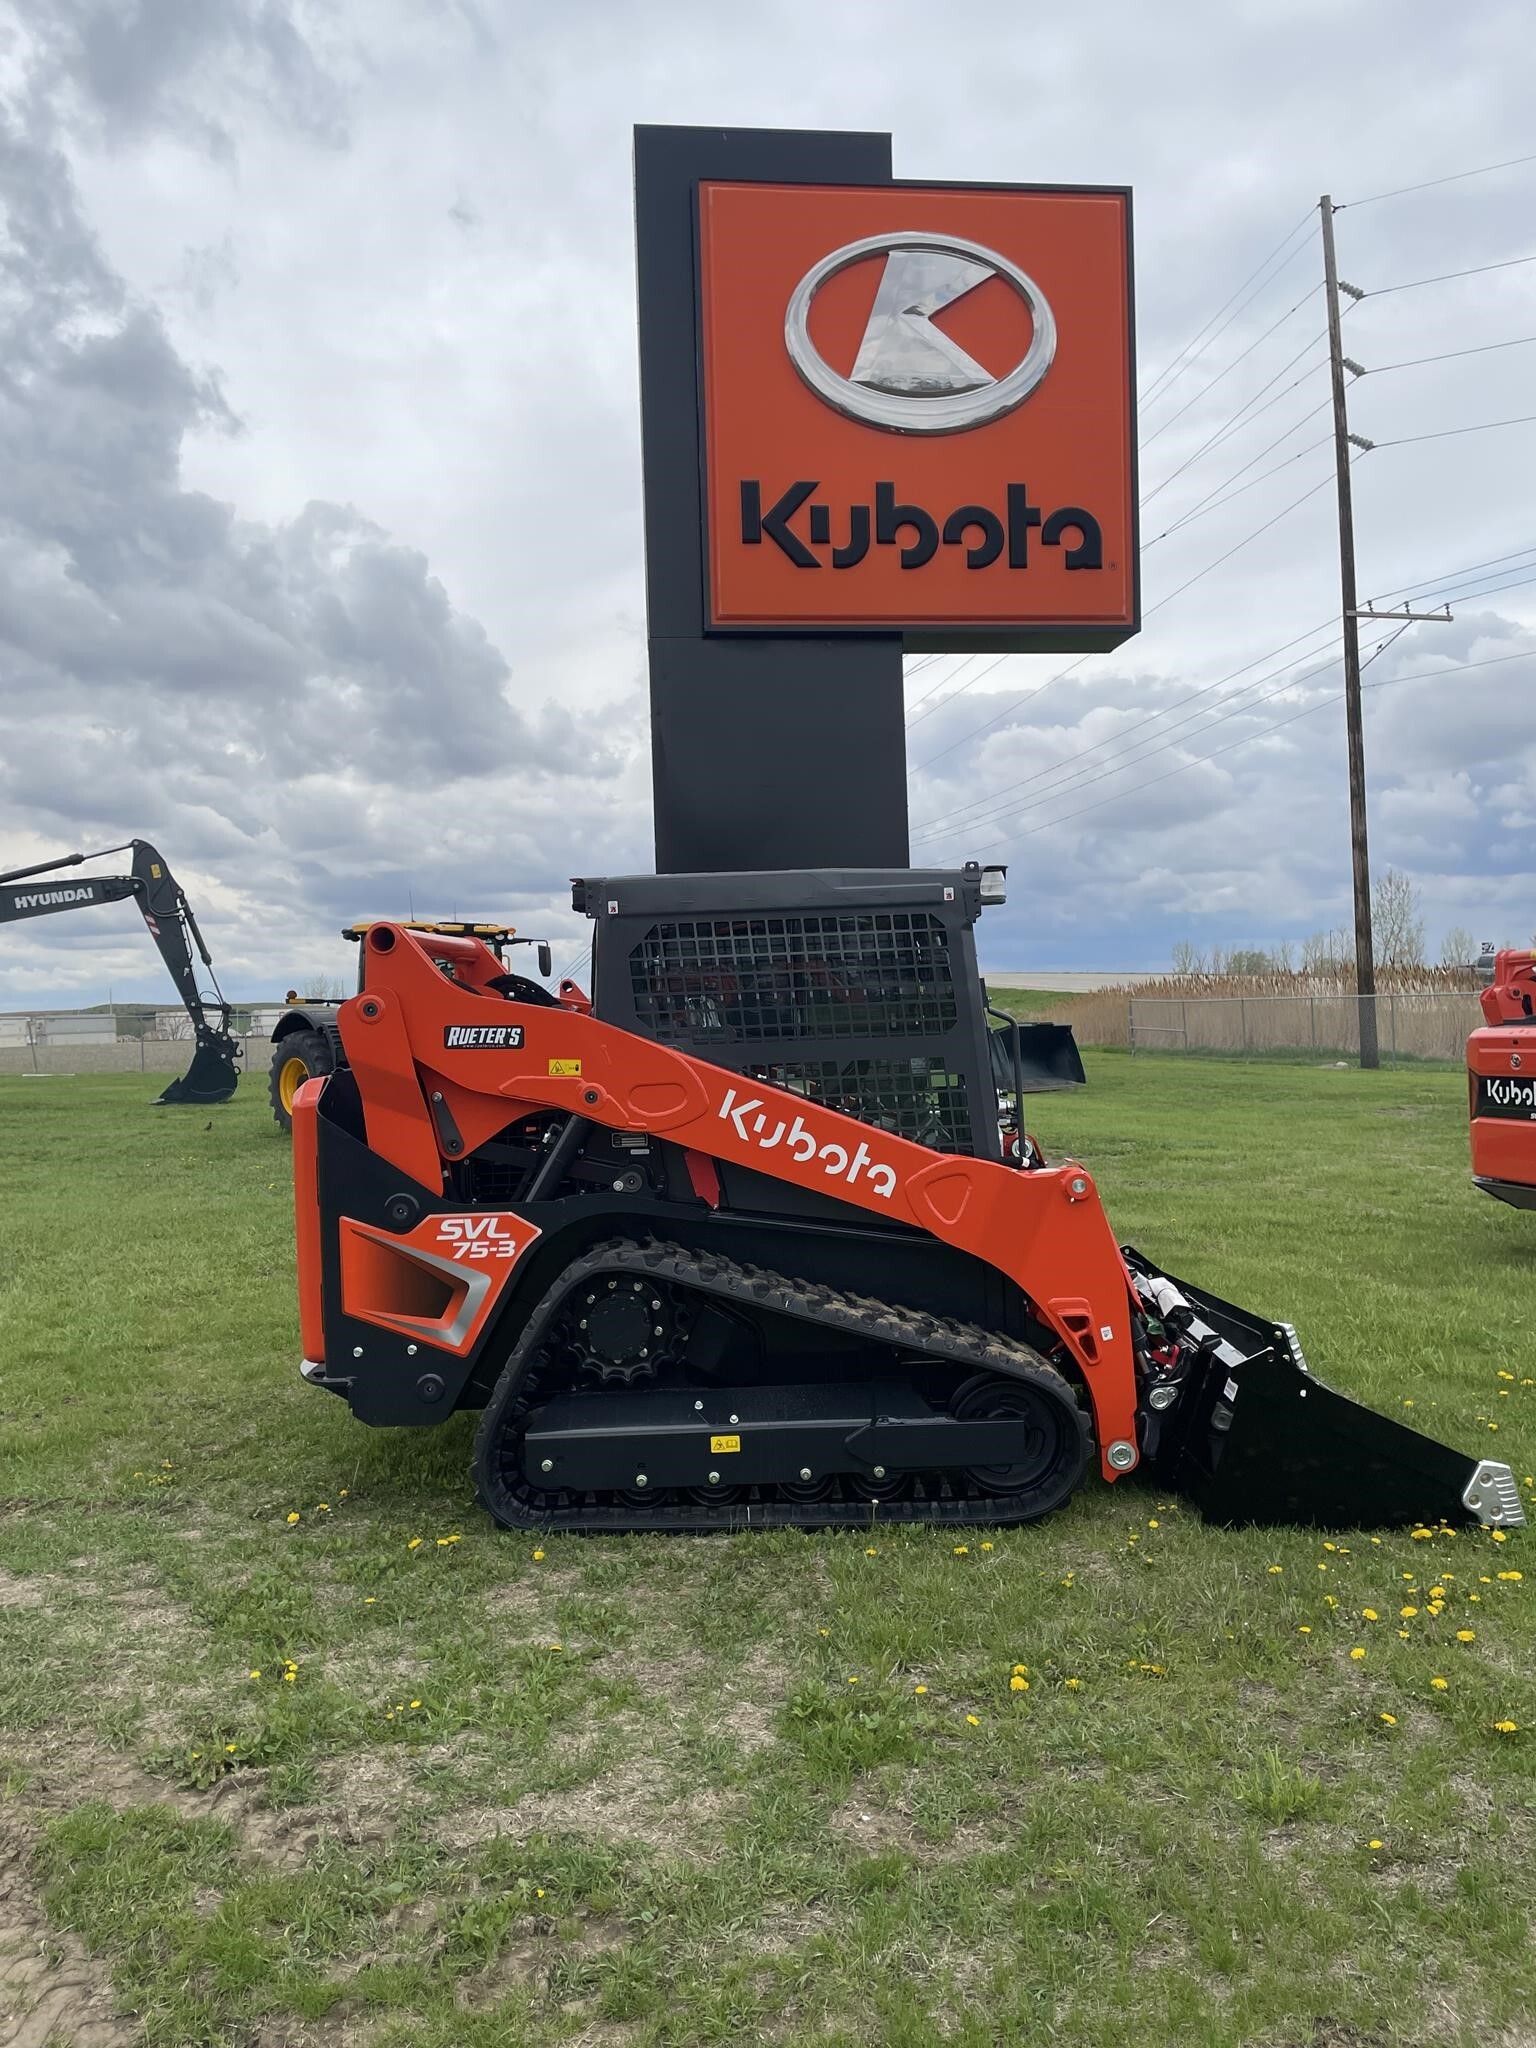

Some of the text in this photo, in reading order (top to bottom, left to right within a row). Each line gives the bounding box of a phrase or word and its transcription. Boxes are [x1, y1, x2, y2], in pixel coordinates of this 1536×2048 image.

[740, 480, 1103, 570] Kubota
[14, 887, 94, 909] HYUNDAI
[447, 1027, 521, 1046] RUETER'S
[718, 1089, 897, 1199] Kubota
[436, 1218, 511, 1240] SVL
[452, 1240, 516, 1259] 75-3
